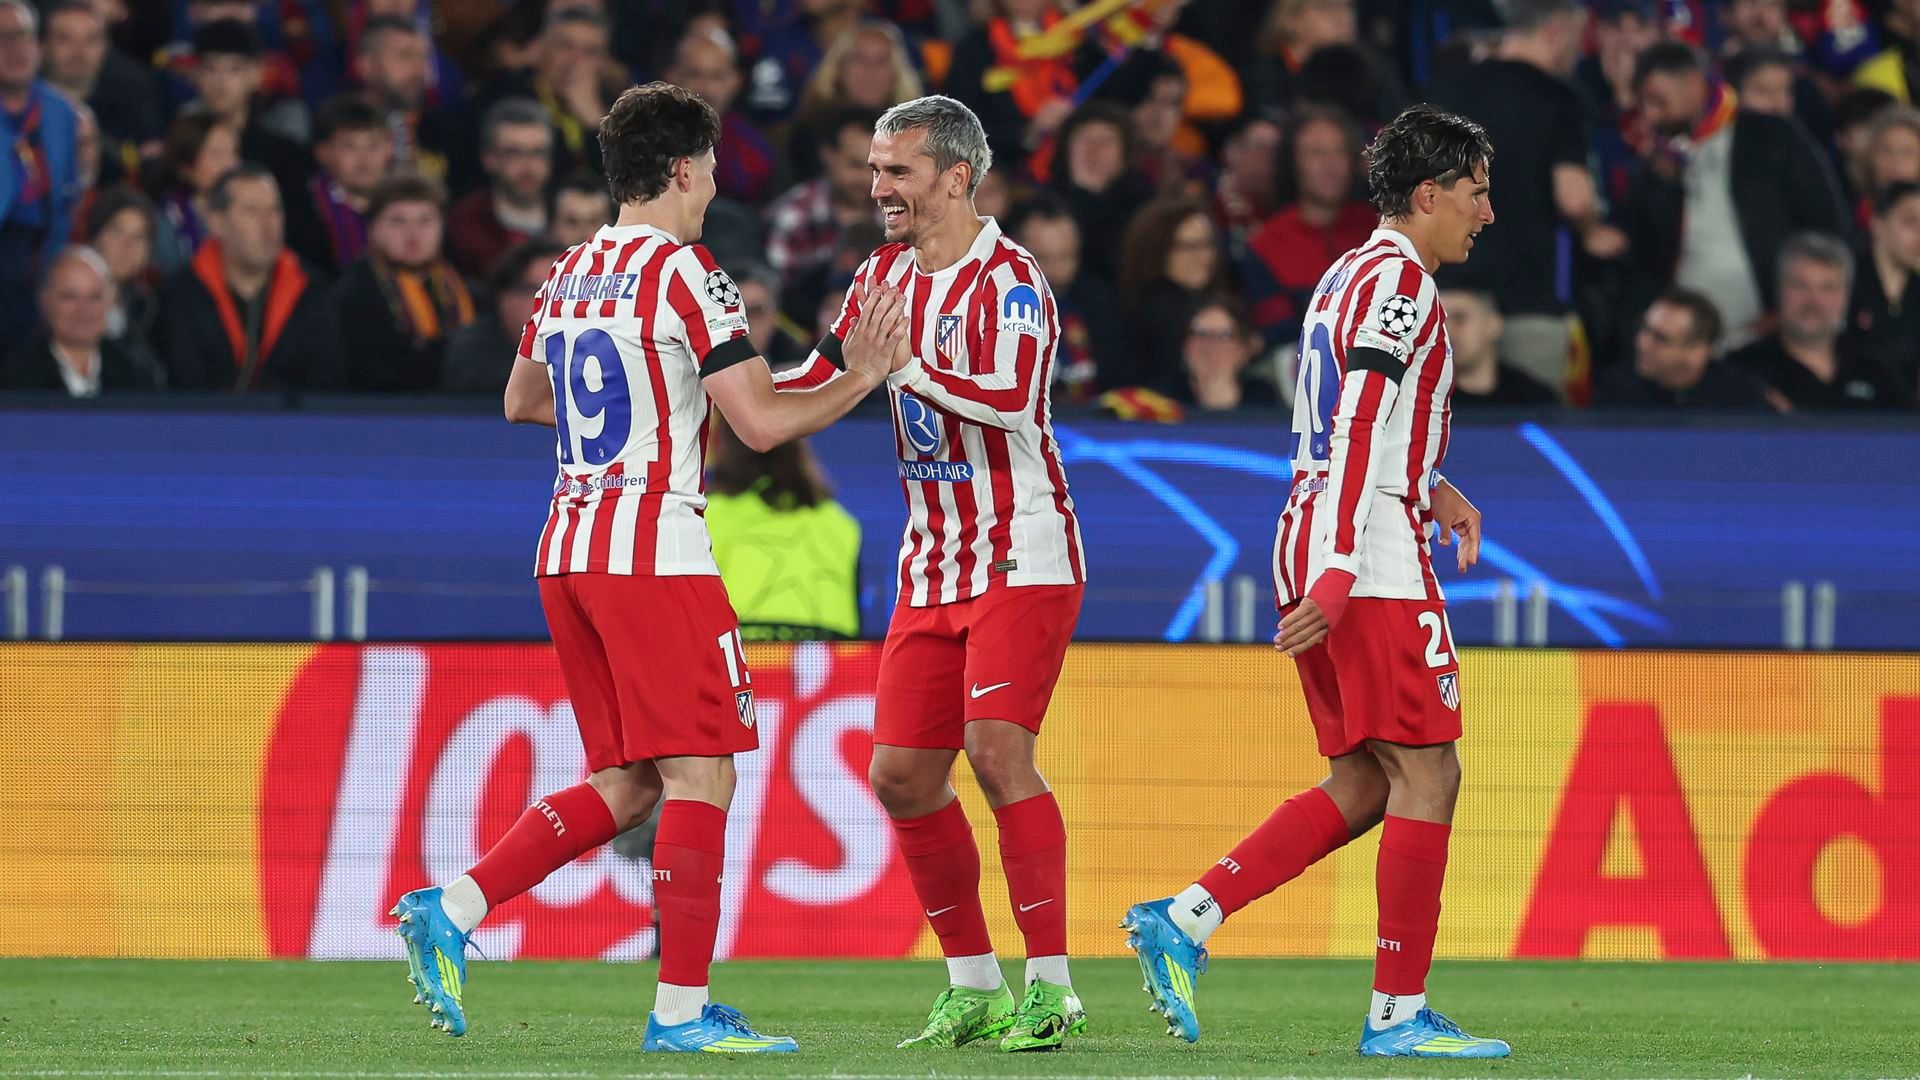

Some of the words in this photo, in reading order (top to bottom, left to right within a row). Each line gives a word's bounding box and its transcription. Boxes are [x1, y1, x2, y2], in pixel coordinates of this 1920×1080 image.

[556, 273, 638, 300] ALVAREZ
[544, 328, 632, 465] 19
[1291, 322, 1340, 460] 0
[594, 474, 646, 490] Children
[944, 463, 971, 480] AIR
[1510, 695, 1920, 960] Ad
